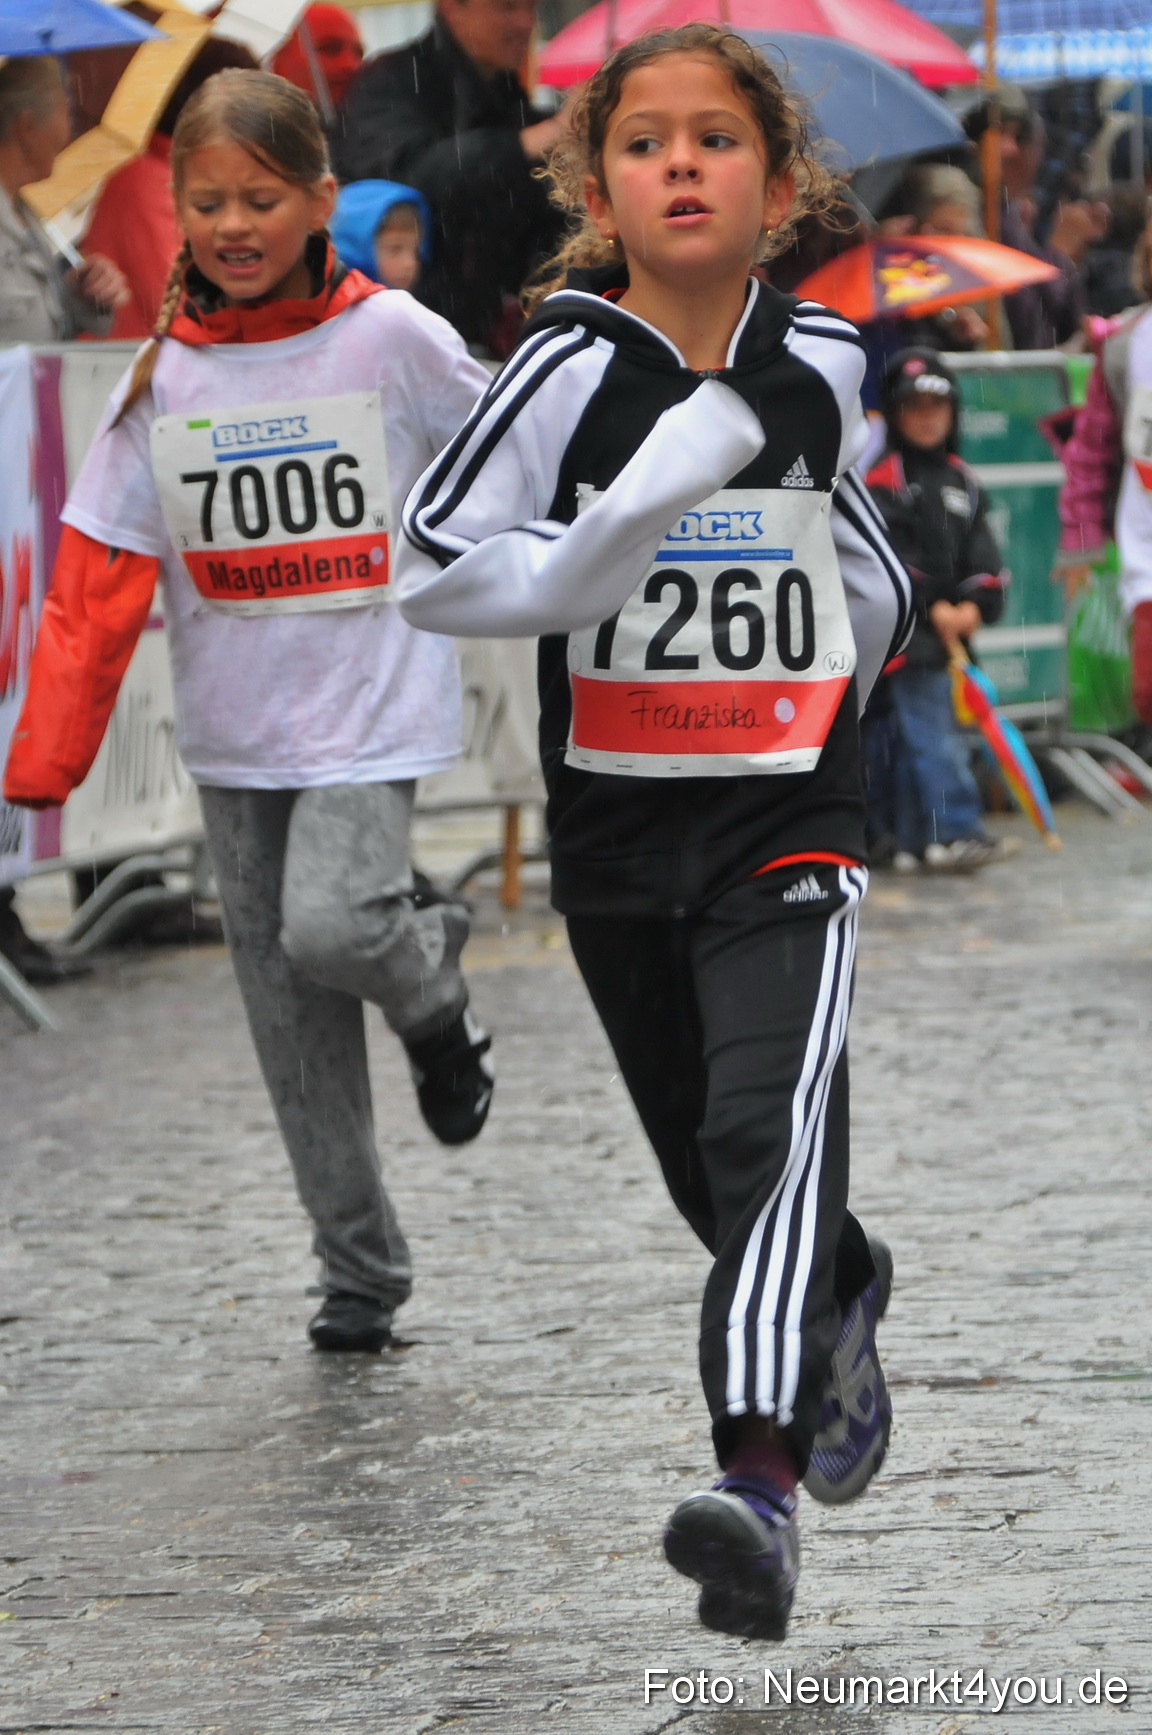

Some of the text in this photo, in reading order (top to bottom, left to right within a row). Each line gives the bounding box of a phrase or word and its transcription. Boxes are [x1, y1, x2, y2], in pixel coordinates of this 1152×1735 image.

[212, 415, 309, 448] BOCK
[180, 453, 365, 542] 7006
[781, 473, 815, 488] adidas
[664, 510, 764, 541] OCK
[206, 550, 372, 597] Magdalena
[627, 690, 762, 730] Franziska
